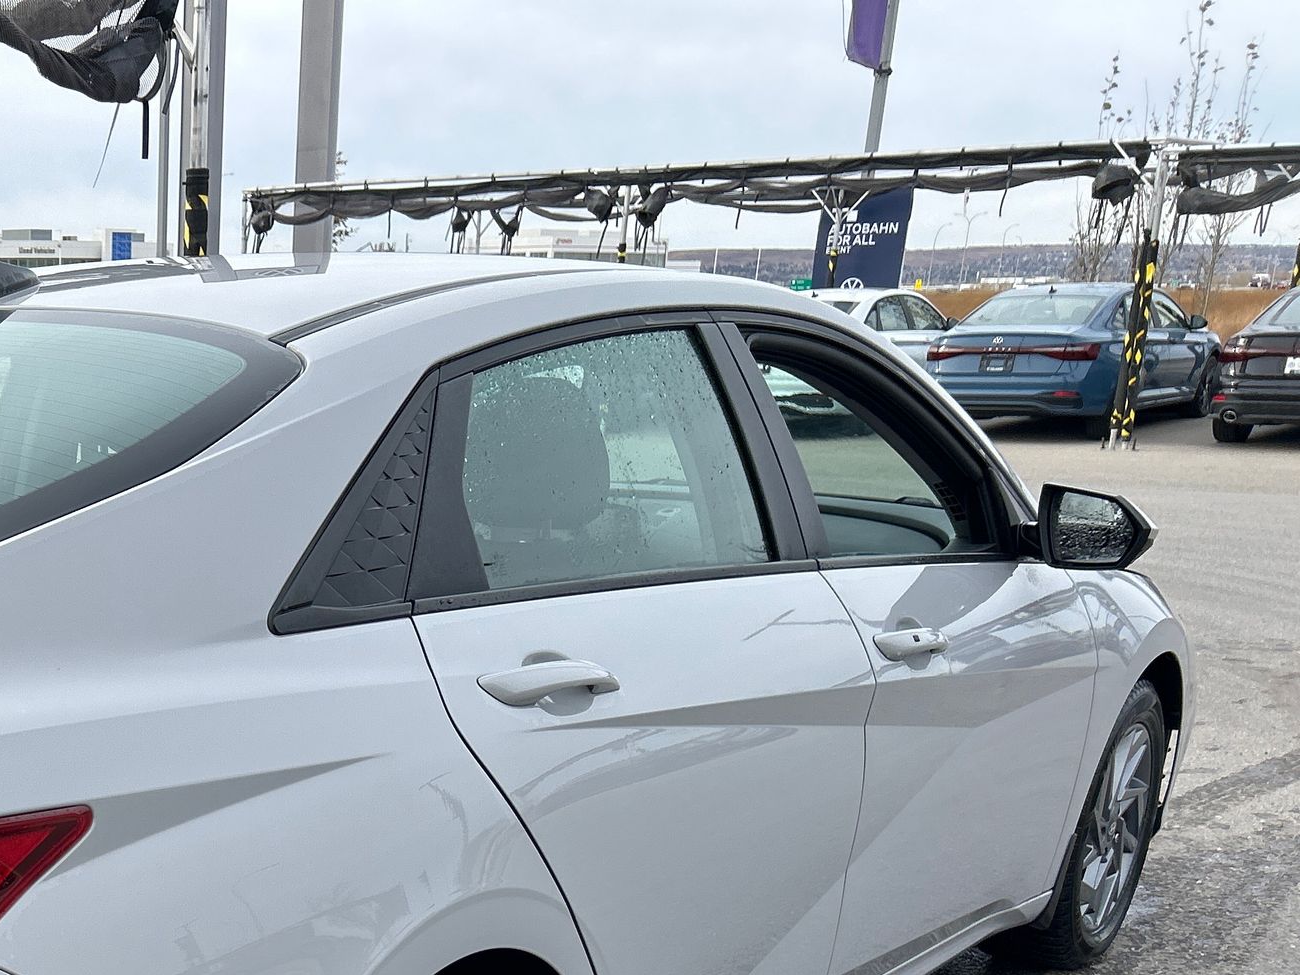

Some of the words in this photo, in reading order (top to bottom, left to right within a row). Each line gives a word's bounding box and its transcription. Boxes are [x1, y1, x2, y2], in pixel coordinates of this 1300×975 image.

[829, 222, 899, 236] AUTOBAHN
[827, 234, 850, 246] FOR
[852, 235, 876, 246] ALL
[826, 246, 851, 255] ENT
